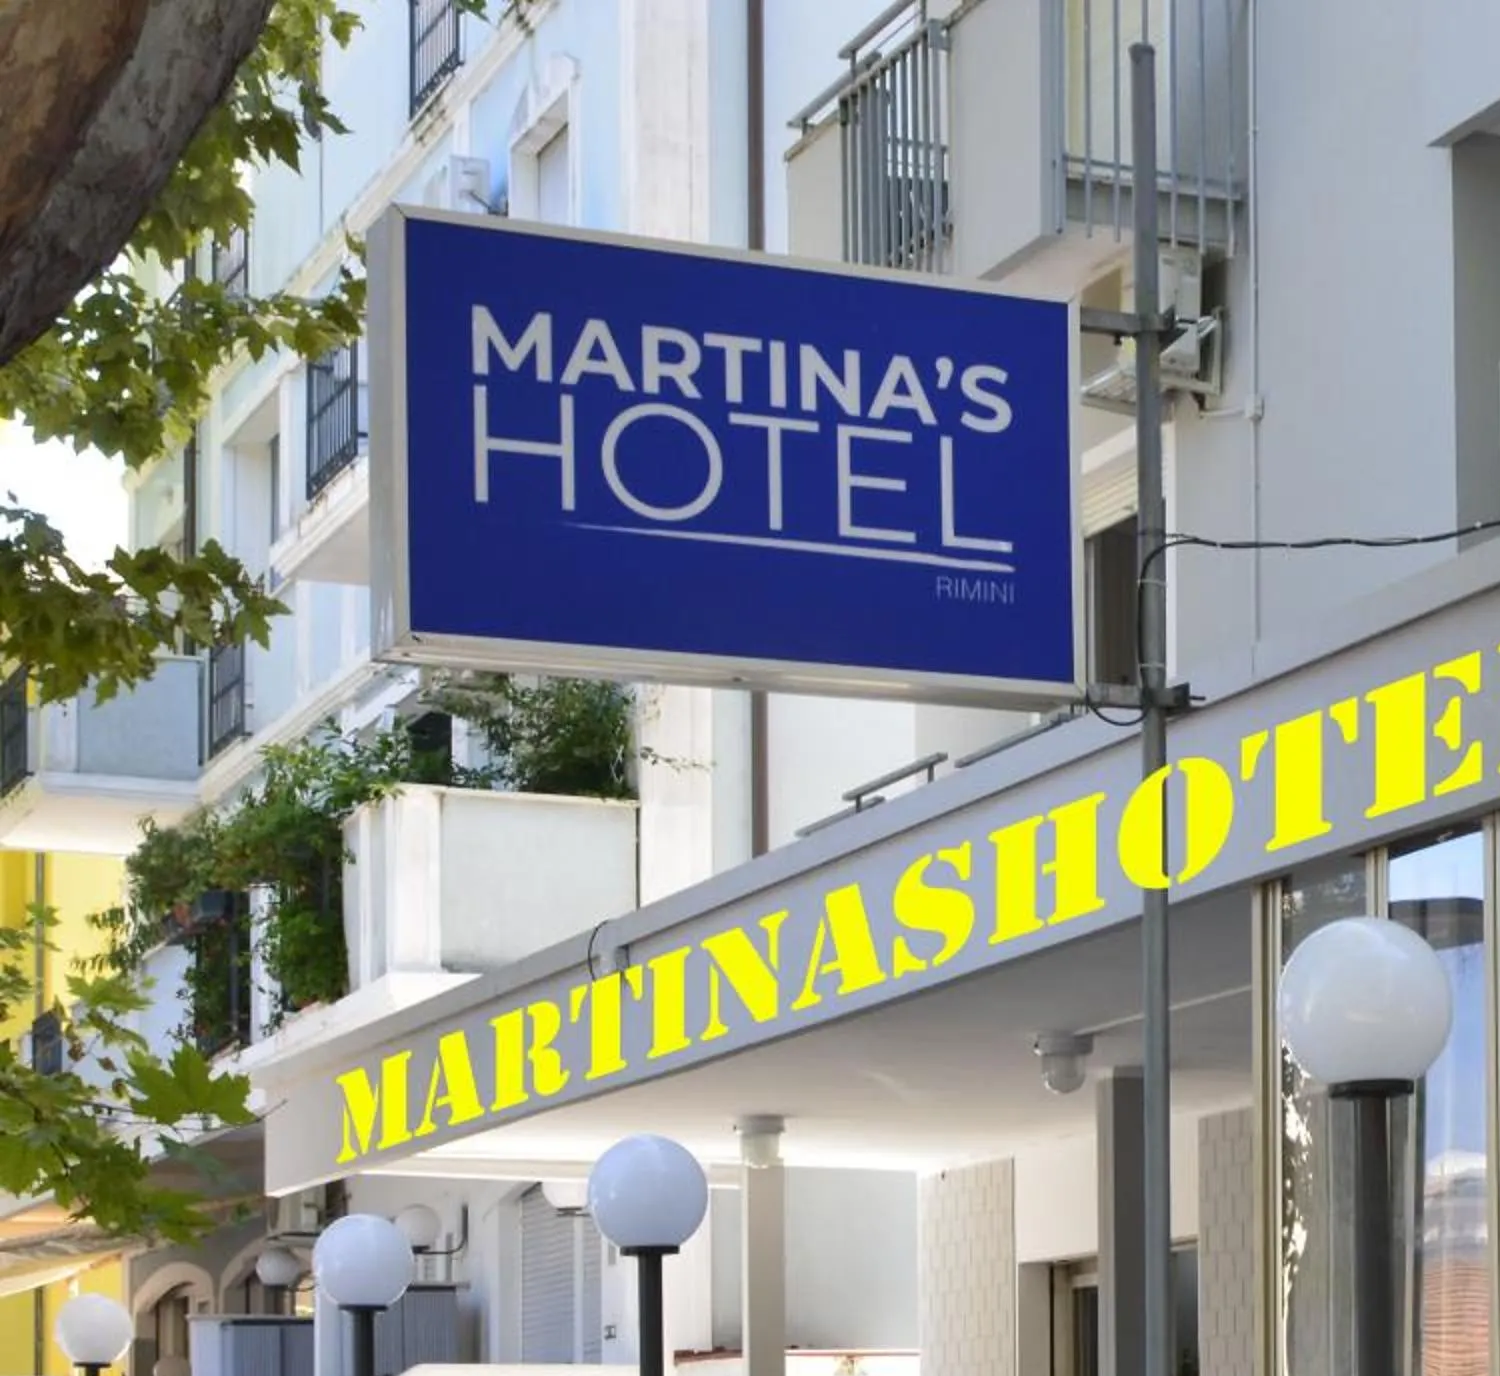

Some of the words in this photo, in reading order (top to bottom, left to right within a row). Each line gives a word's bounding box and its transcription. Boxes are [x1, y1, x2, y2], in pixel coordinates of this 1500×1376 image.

[472, 305, 1013, 434] MARTINA'S
[474, 385, 1014, 553] HOTEL
[936, 575, 1015, 605] RIMINI
